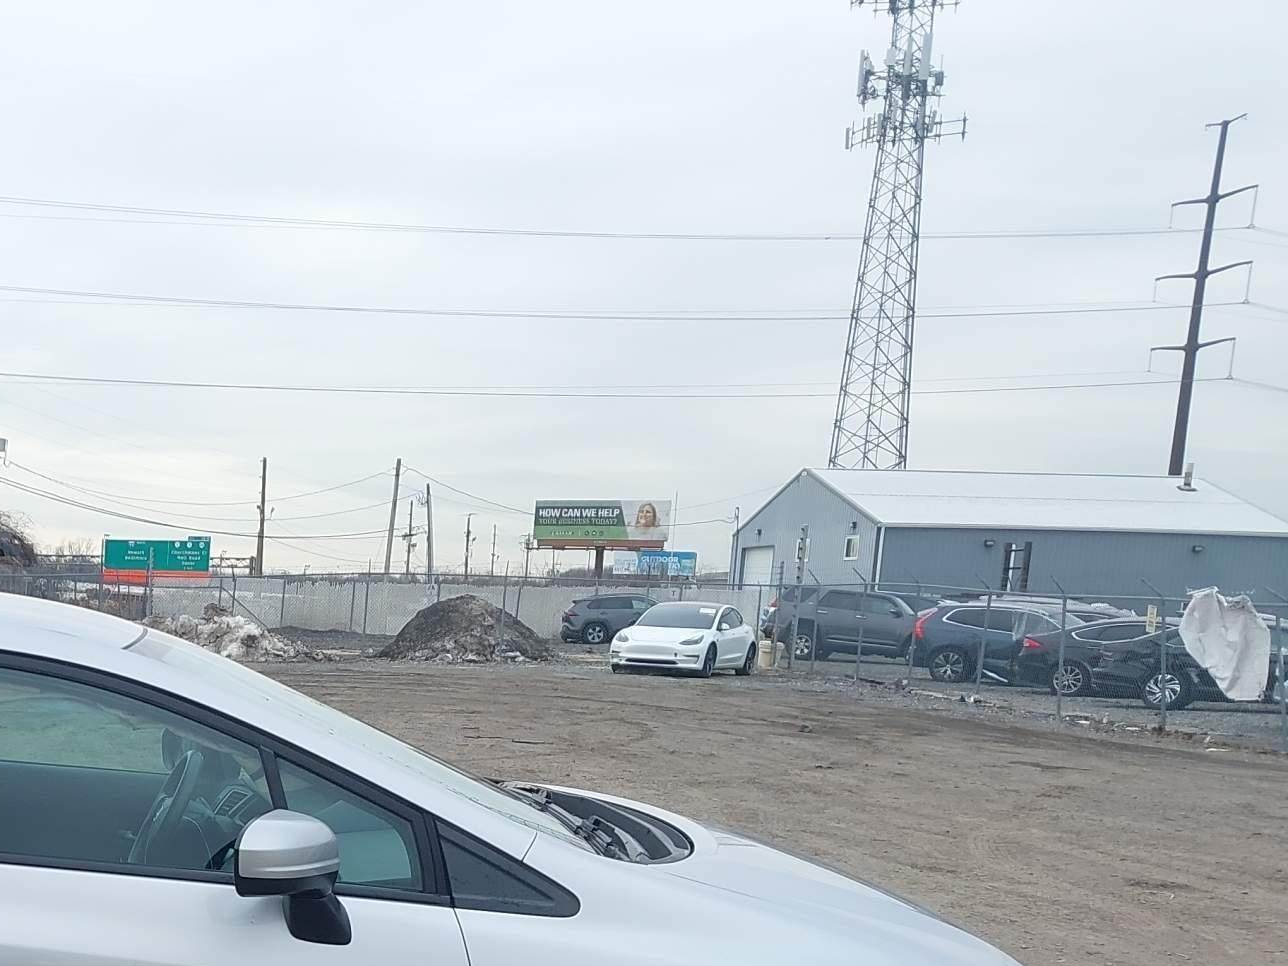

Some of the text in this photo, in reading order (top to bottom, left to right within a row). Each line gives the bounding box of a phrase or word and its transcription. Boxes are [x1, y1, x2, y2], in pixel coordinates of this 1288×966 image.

[539, 508, 620, 517] HOW CAN WE HELP
